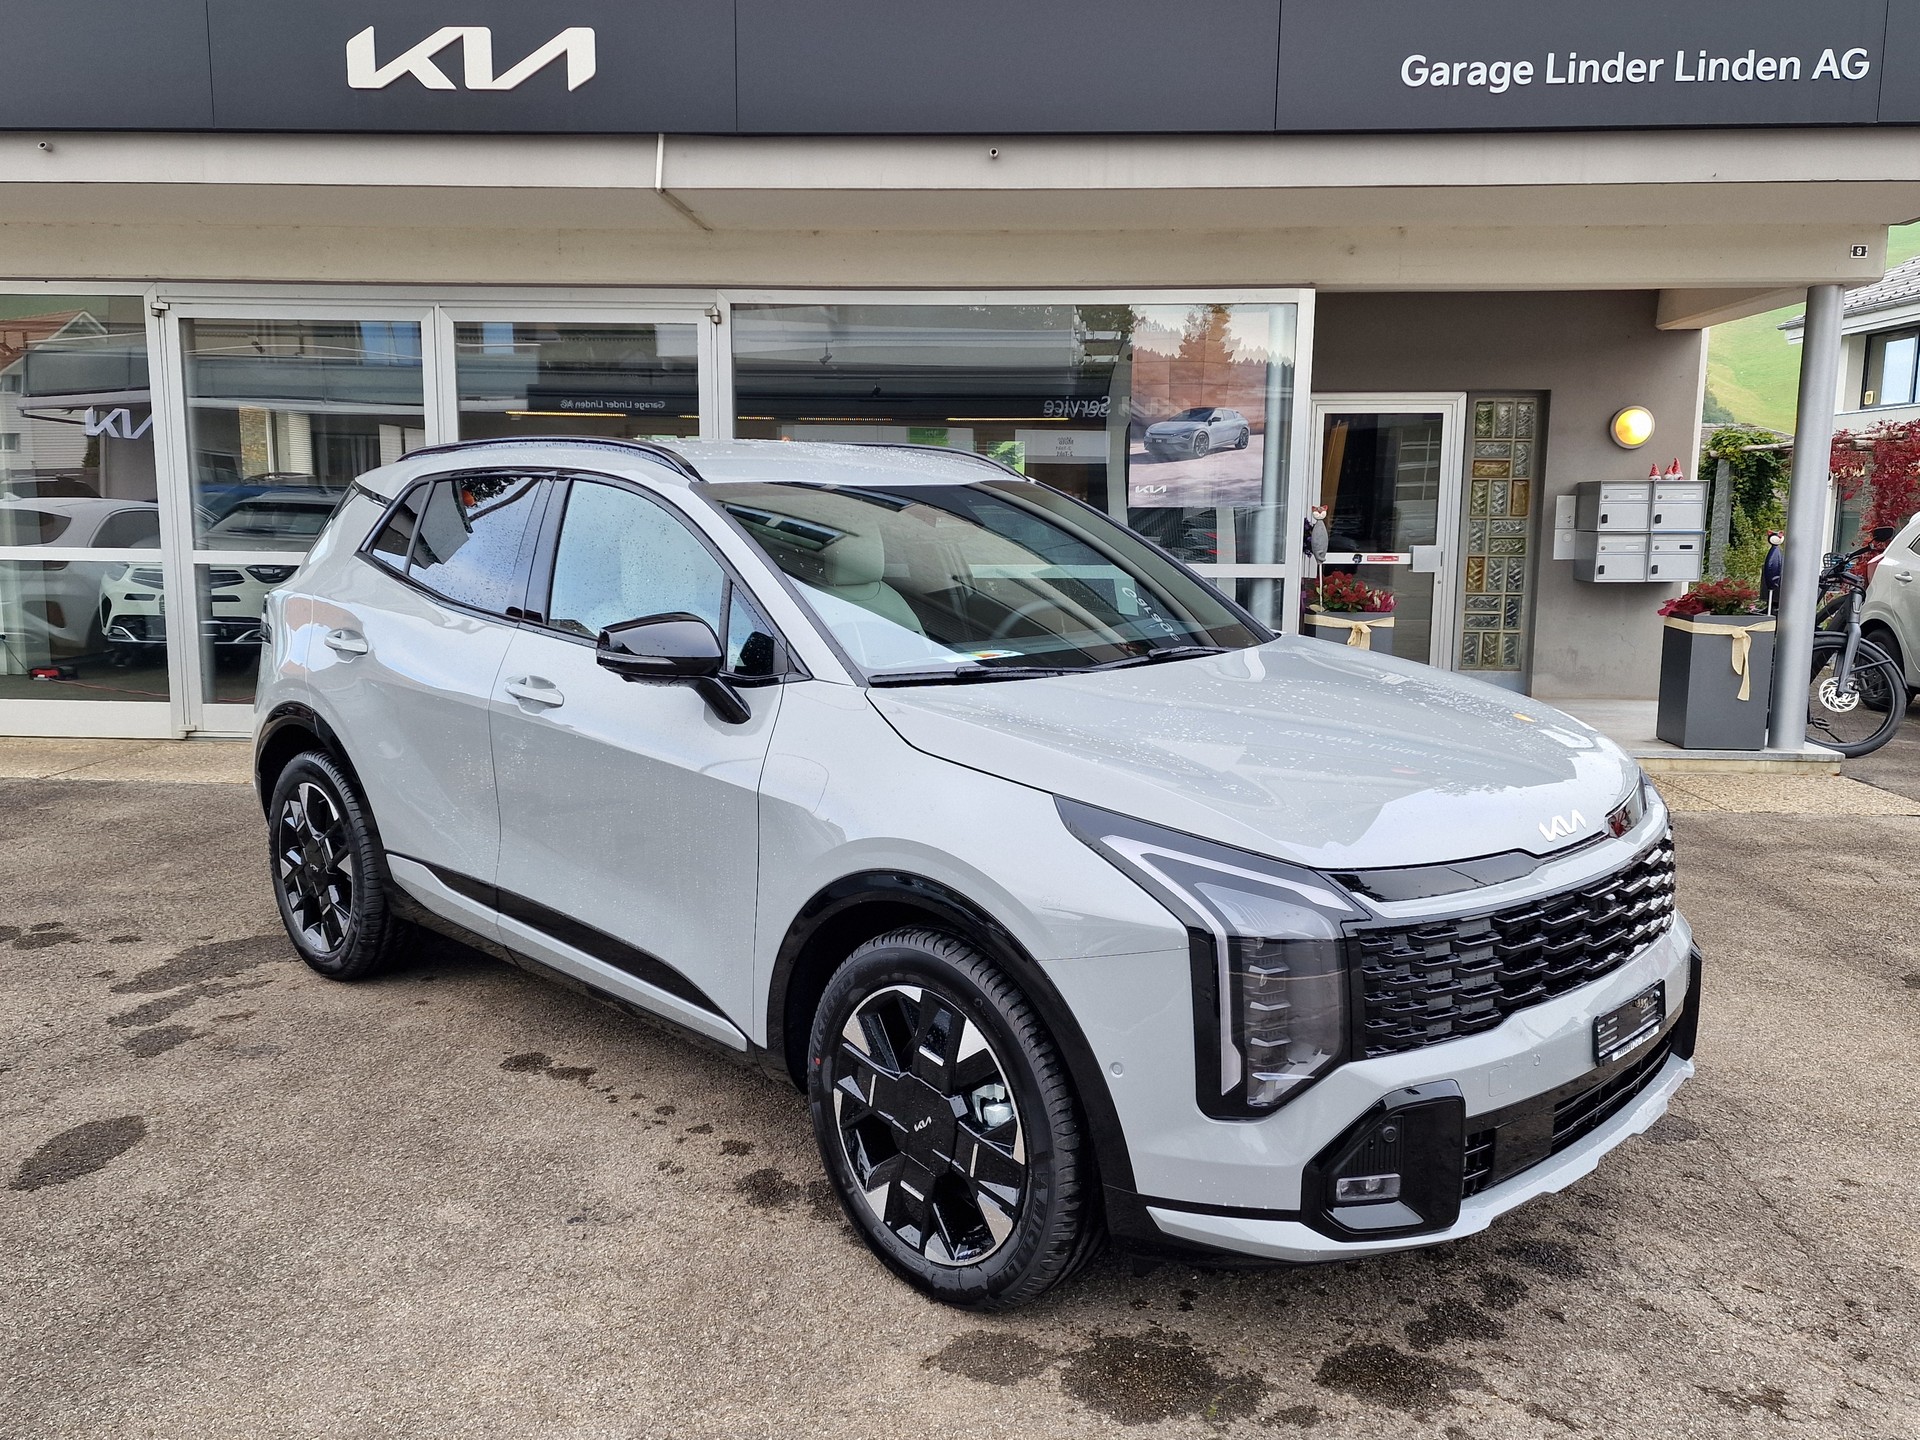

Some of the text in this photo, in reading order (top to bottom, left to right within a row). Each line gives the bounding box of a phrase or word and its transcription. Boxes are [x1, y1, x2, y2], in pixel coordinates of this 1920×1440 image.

[346, 26, 596, 91] KIA
[1400, 47, 1871, 94] Garage Linder Linden AG
[1856, 246, 1863, 256] 9
